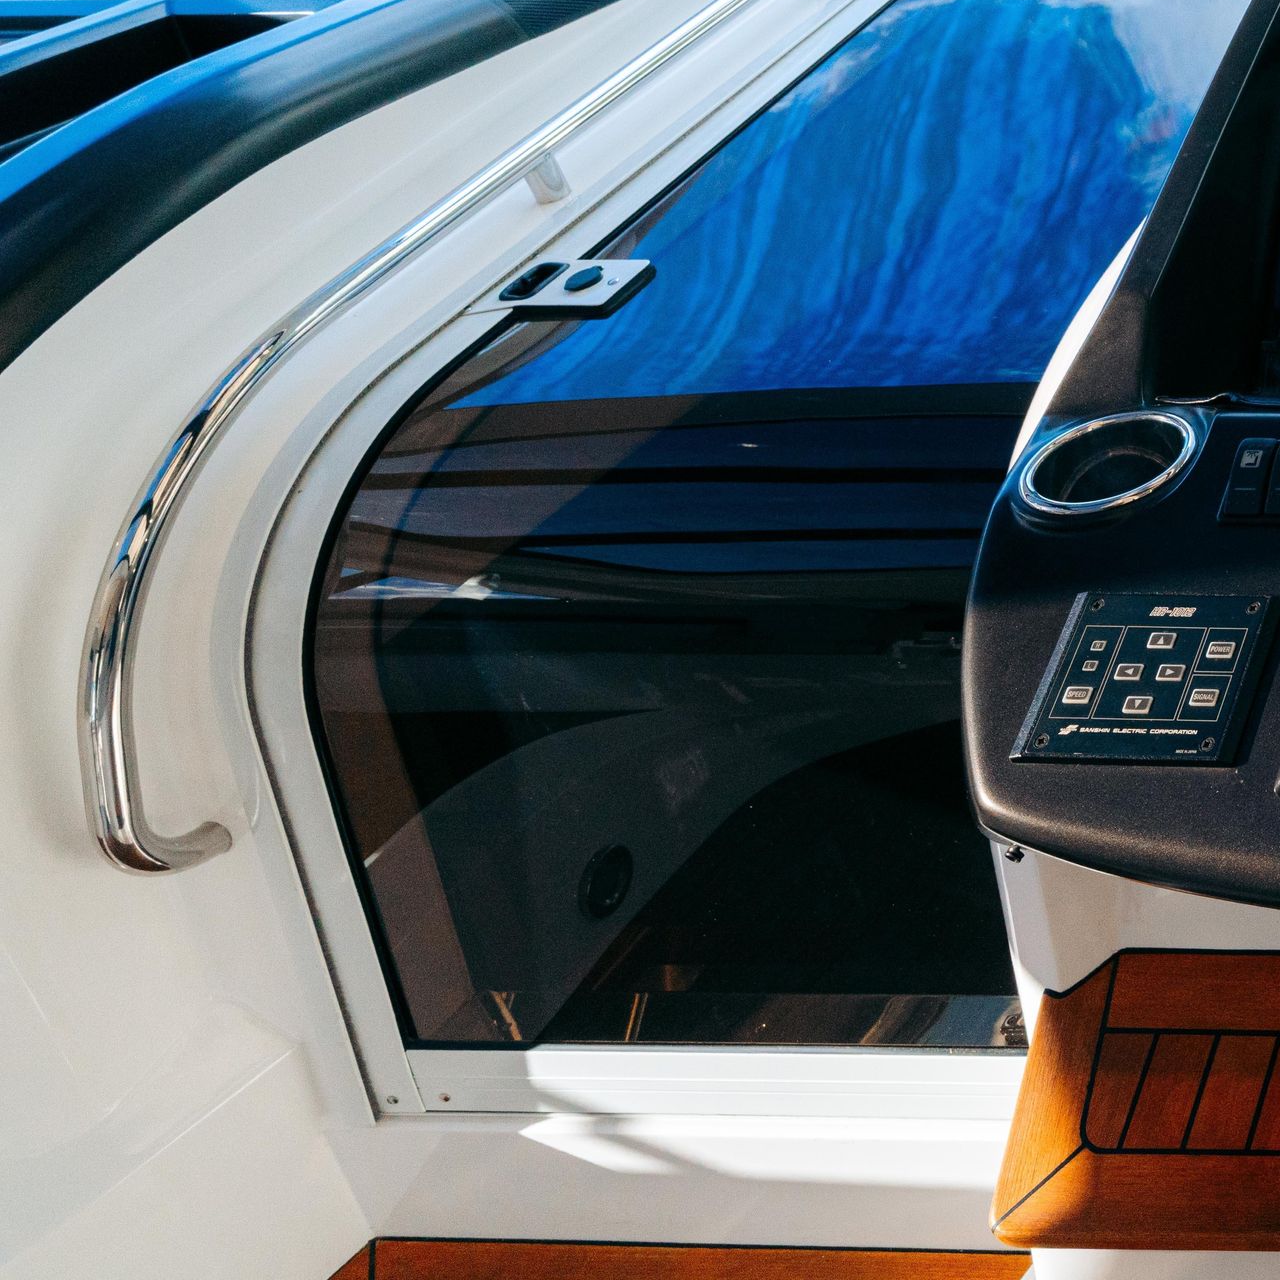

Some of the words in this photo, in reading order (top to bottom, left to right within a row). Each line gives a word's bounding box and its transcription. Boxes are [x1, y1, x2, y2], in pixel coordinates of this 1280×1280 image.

[1210, 646, 1232, 654] POWER
[1067, 690, 1087, 698] SPEED
[1193, 693, 1215, 701] SIGNAL
